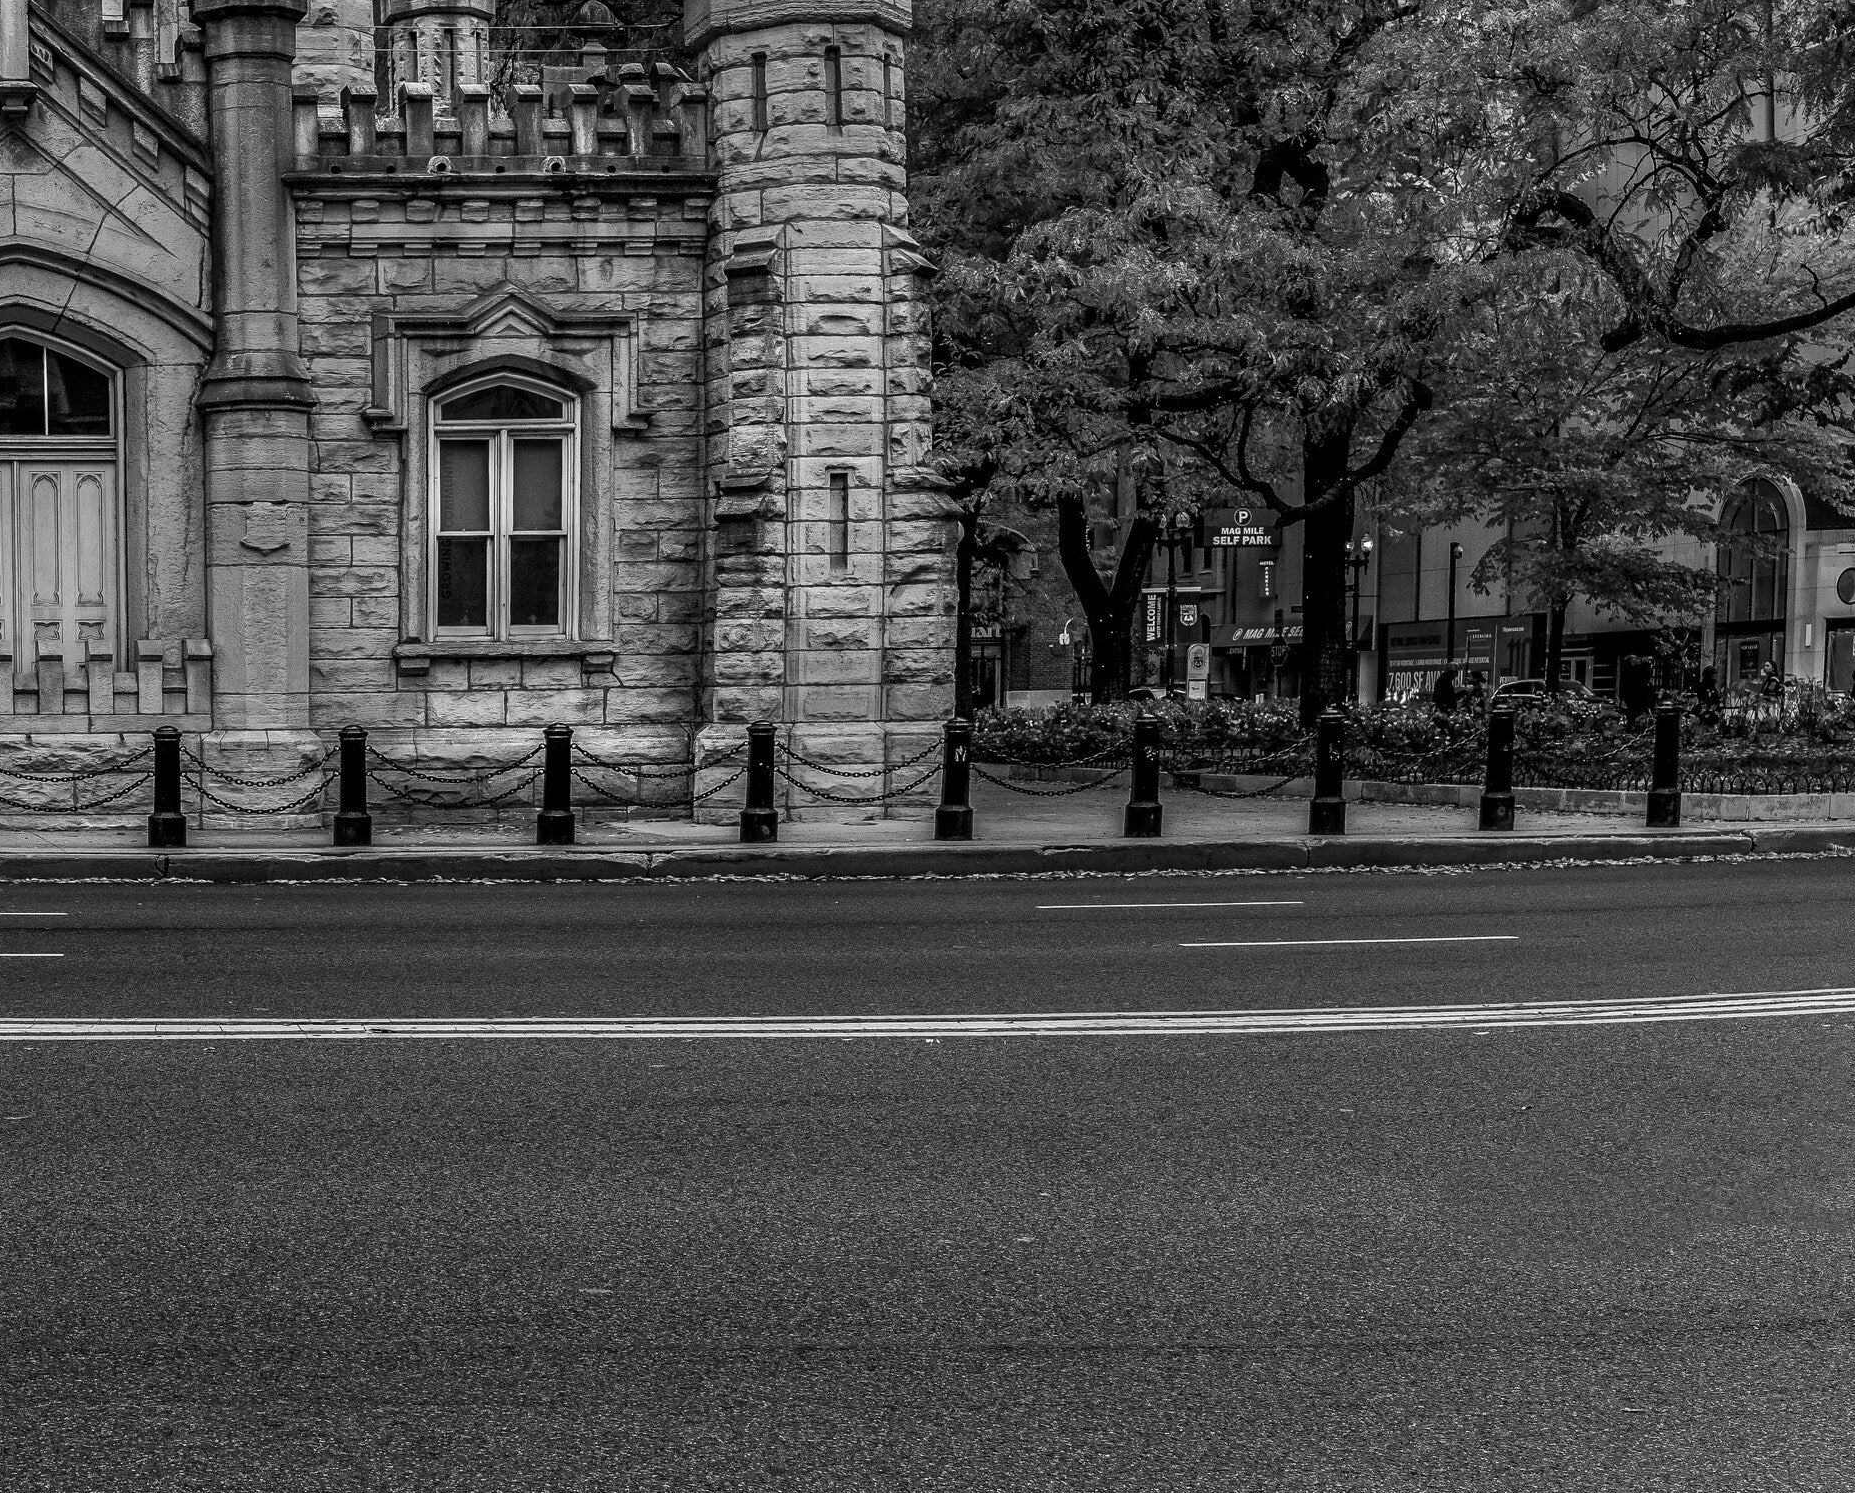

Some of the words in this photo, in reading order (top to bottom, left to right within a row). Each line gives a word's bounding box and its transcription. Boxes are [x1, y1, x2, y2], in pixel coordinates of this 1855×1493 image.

[1221, 527, 1241, 535] MAG
[1243, 526, 1265, 535] MILE
[1212, 536, 1240, 545] SELF
[1242, 535, 1272, 545] PARK
[441, 539, 452, 599] GROWING
[1146, 594, 1156, 642] WELCOME
[1242, 628, 1265, 639] MAG
[1271, 645, 1286, 657] STOP
[1413, 671, 1424, 689] SF
